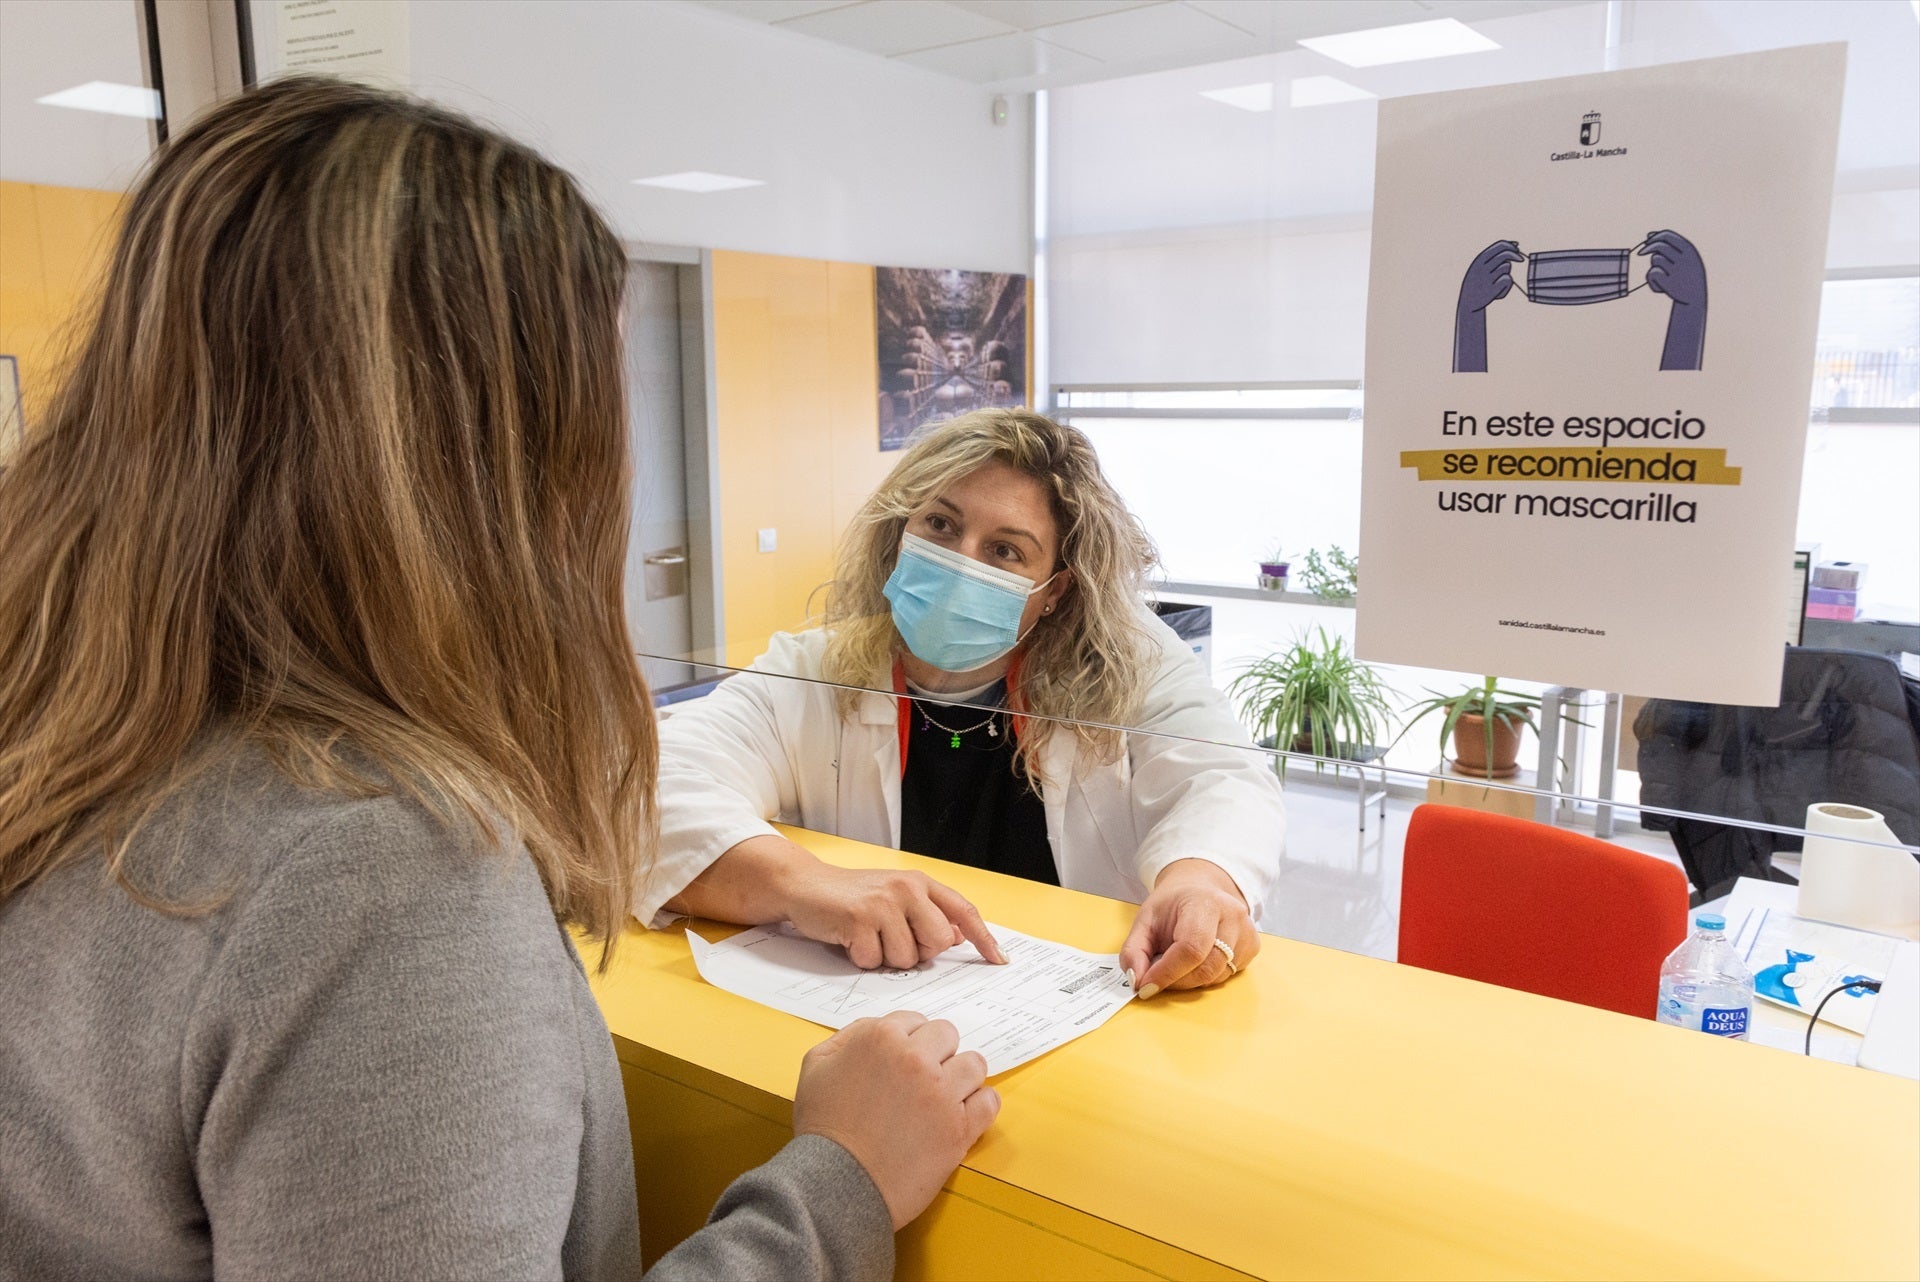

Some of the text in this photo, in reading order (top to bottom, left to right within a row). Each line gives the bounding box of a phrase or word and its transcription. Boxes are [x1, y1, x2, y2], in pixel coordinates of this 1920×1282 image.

[1550, 147, 1627, 161] Castilla-La Mancha
[1442, 409, 1706, 447] En este espacio
[1443, 450, 1697, 481] se recomienda
[1438, 491, 1697, 523] usar mascarilla
[1499, 620, 1606, 636] sanidad.castillalamancha.es
[1707, 1012, 1746, 1023] AQUA
[1708, 1021, 1745, 1031] DEUS
